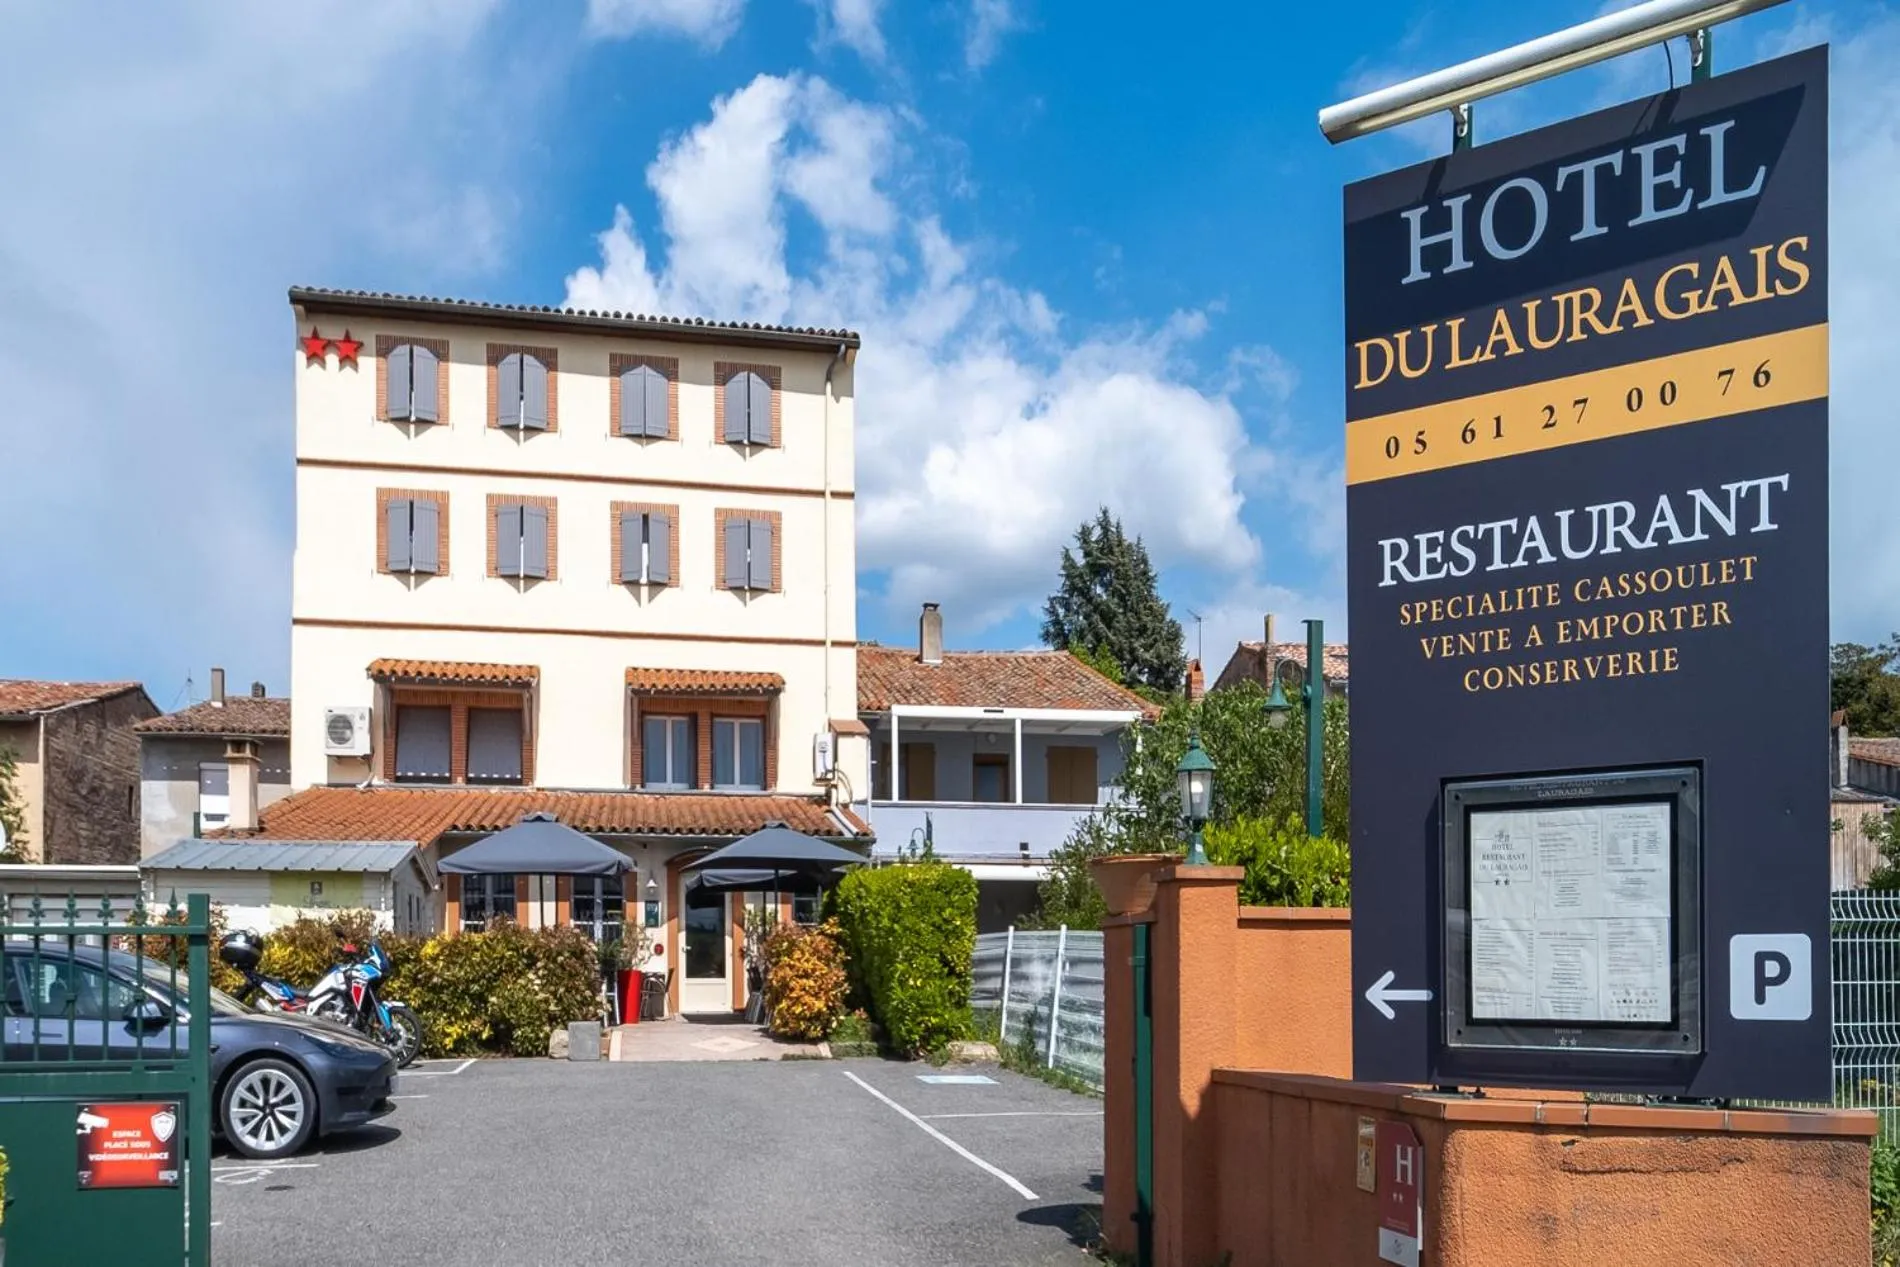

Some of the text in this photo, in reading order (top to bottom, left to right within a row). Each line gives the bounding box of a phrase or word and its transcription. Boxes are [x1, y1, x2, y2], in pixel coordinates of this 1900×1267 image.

[1401, 120, 1767, 284] HOTEL
[1354, 236, 1811, 389] DU LAURAGAIS
[1386, 359, 1772, 459] 05 61 27 00 76
[1378, 474, 1790, 588] RESTAURANT
[1400, 556, 1759, 626] SPECIALITE CASSOULET
[1420, 601, 1733, 660] VENTE A EMPORTER
[1464, 649, 1679, 692] CONSERVERIE
[1754, 950, 1791, 1005] P
[1395, 1144, 1414, 1186] H
